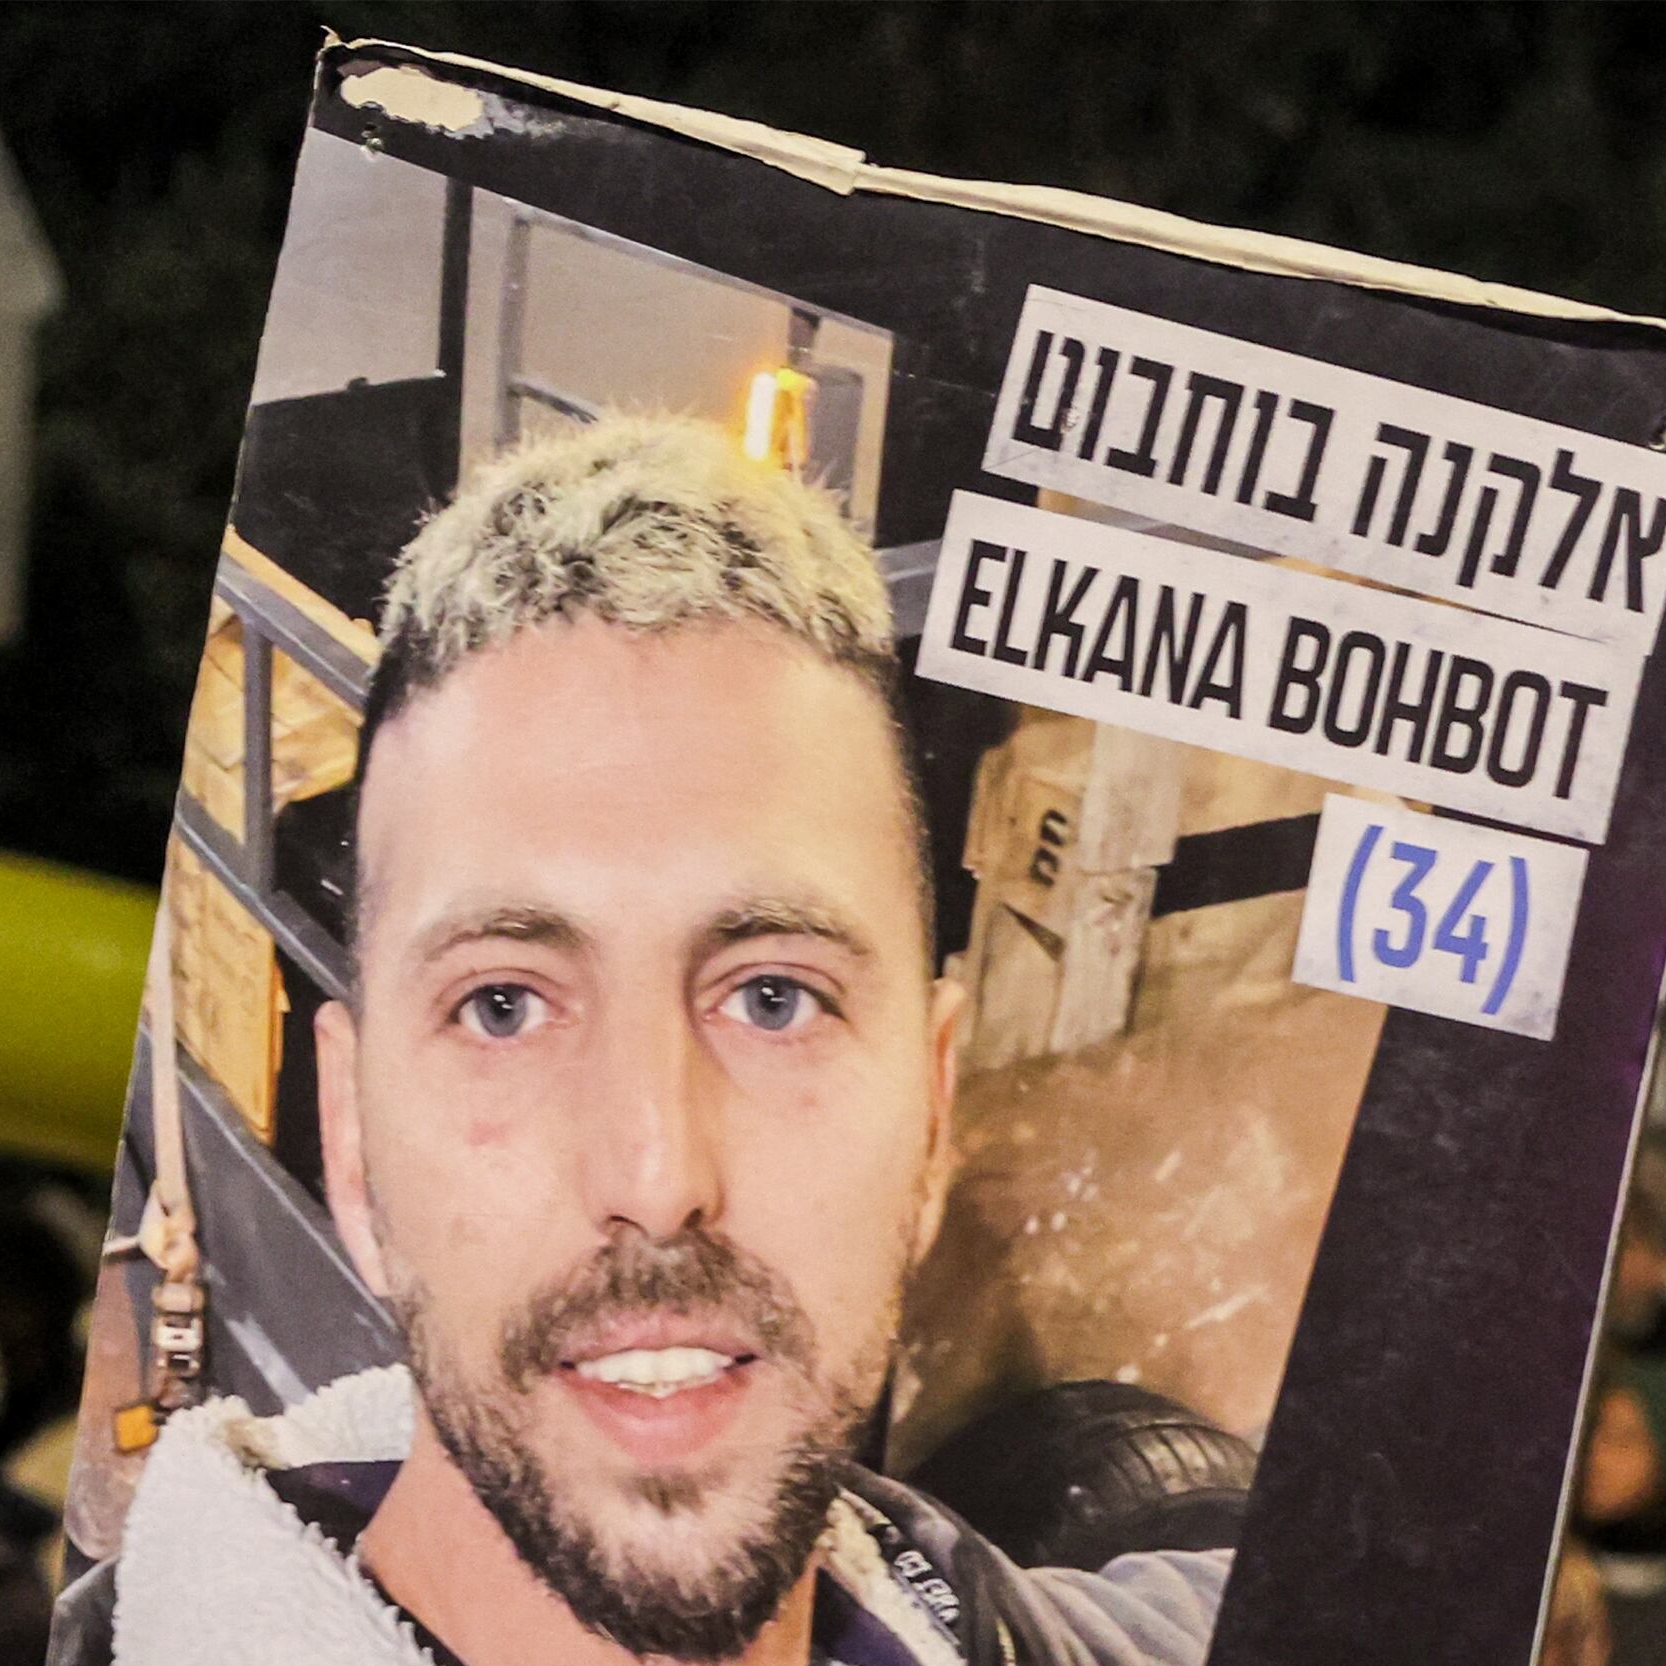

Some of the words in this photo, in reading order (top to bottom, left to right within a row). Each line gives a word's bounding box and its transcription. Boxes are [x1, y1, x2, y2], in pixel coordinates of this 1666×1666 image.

[1012, 329, 1336, 523] בוחבוט
[950, 537, 1251, 720] ELKANA
[1268, 615, 1608, 800] BOHBOT
[1336, 823, 1530, 1015] (34)
